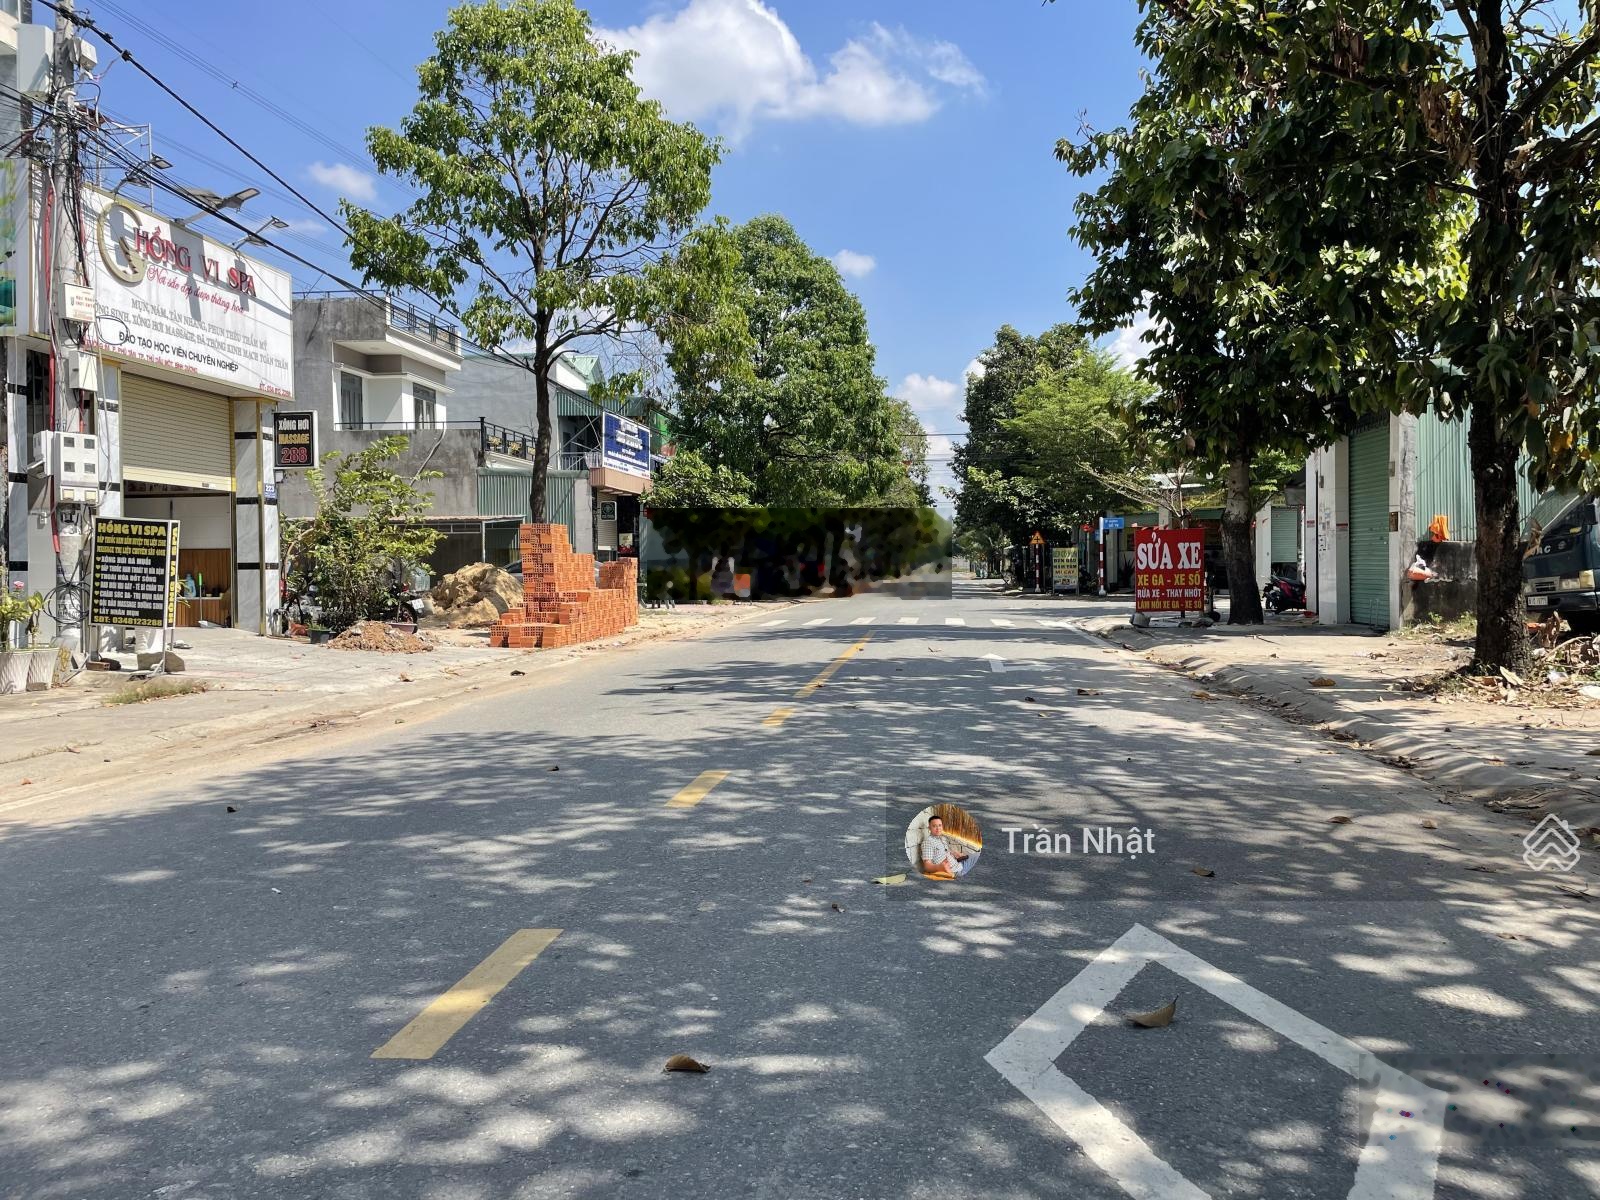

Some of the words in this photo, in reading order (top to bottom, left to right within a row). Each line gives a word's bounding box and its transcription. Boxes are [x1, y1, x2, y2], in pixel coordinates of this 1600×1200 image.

[134, 225, 192, 272] HỒNG
[200, 254, 220, 282] VI
[227, 266, 256, 297] SPA
[137, 336, 153, 350] TẠO
[154, 340, 170, 354] HỌC
[171, 346, 187, 359] VIÊN
[189, 351, 215, 368] CHUYÊN
[217, 359, 239, 372] NGHIỆP
[278, 418, 296, 431] XÔNG
[298, 418, 310, 430] HƠI
[278, 433, 310, 445] MASSAGE
[281, 447, 308, 463] 288
[130, 525, 142, 536] VI
[144, 525, 166, 537] SPA
[1137, 531, 1173, 570] SỬA
[1177, 541, 1202, 569] XE
[1137, 574, 1149, 586] XE
[1151, 573, 1164, 586] GA
[1174, 573, 1185, 586] XE
[1188, 570, 1201, 586] SỐ
[1137, 587, 1150, 598] RỬA
[1152, 588, 1160, 598] XE
[1167, 588, 1182, 598] THAY
[1184, 587, 1202, 598] NHỚT
[1163, 600, 1170, 608] XE
[1171, 600, 1179, 608] GA
[1185, 600, 1192, 608] XE
